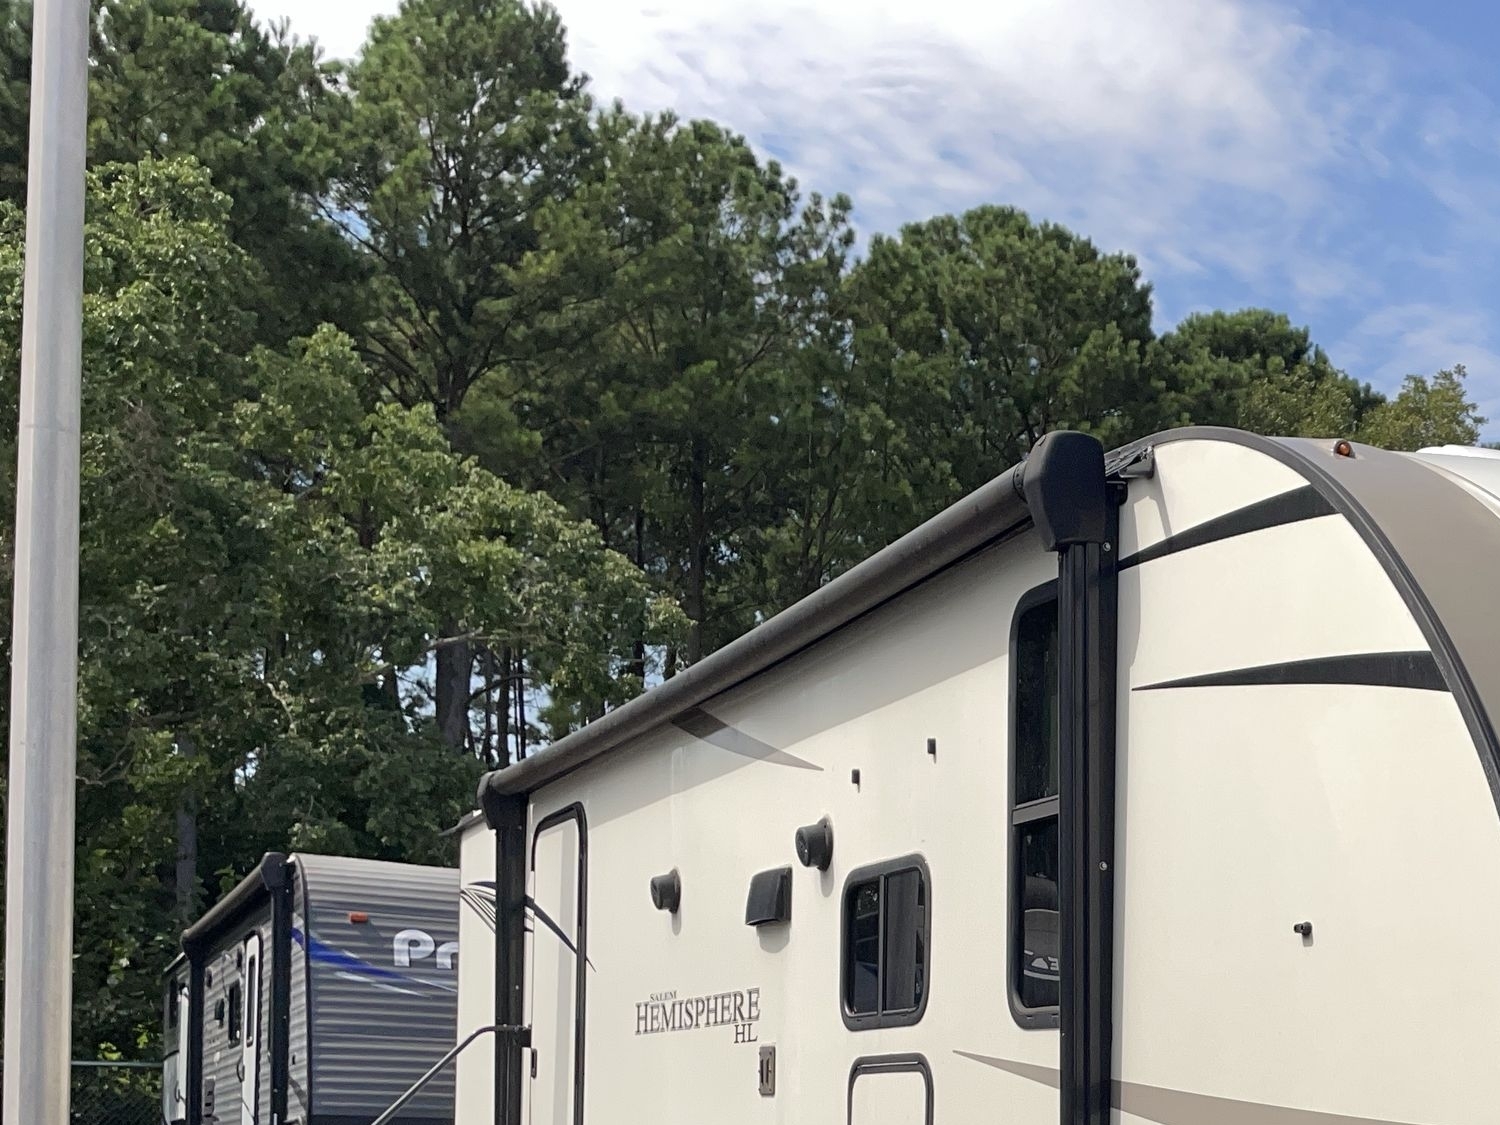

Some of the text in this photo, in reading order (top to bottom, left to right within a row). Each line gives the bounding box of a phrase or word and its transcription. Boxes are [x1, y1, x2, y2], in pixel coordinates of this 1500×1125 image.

[649, 990, 678, 1002] SALEM
[635, 987, 761, 1036] HEMISPHERE
[734, 1023, 758, 1044] HL
